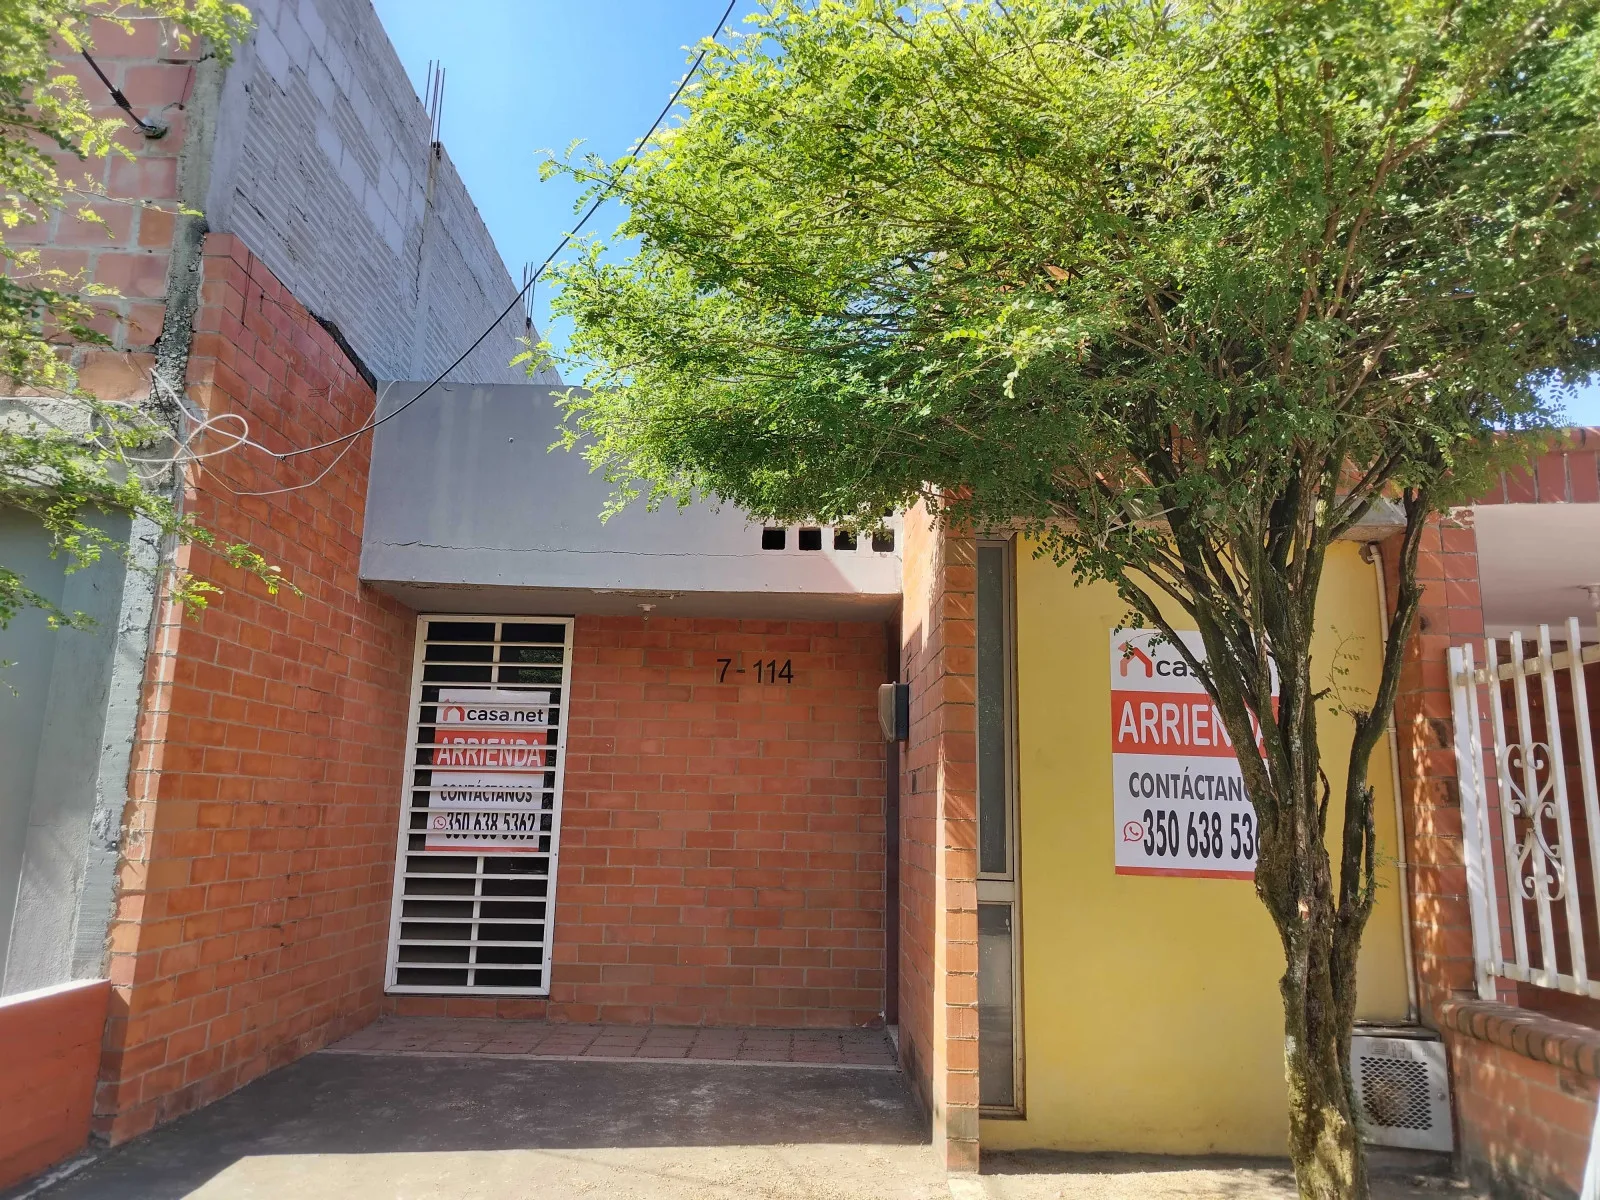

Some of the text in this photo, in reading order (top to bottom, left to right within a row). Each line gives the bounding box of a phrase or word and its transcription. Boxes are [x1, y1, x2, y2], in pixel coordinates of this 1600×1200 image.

[716, 658, 794, 684] 7-114
[466, 708, 544, 723] casa.net
[1118, 700, 1263, 748] ARRIEN
[436, 736, 542, 767] ARRIENDA
[440, 779, 533, 803] CONTÁCTANOS
[445, 812, 536, 841] 350 638 5362
[1143, 808, 1180, 857] 350
[1186, 811, 1223, 859] 638
